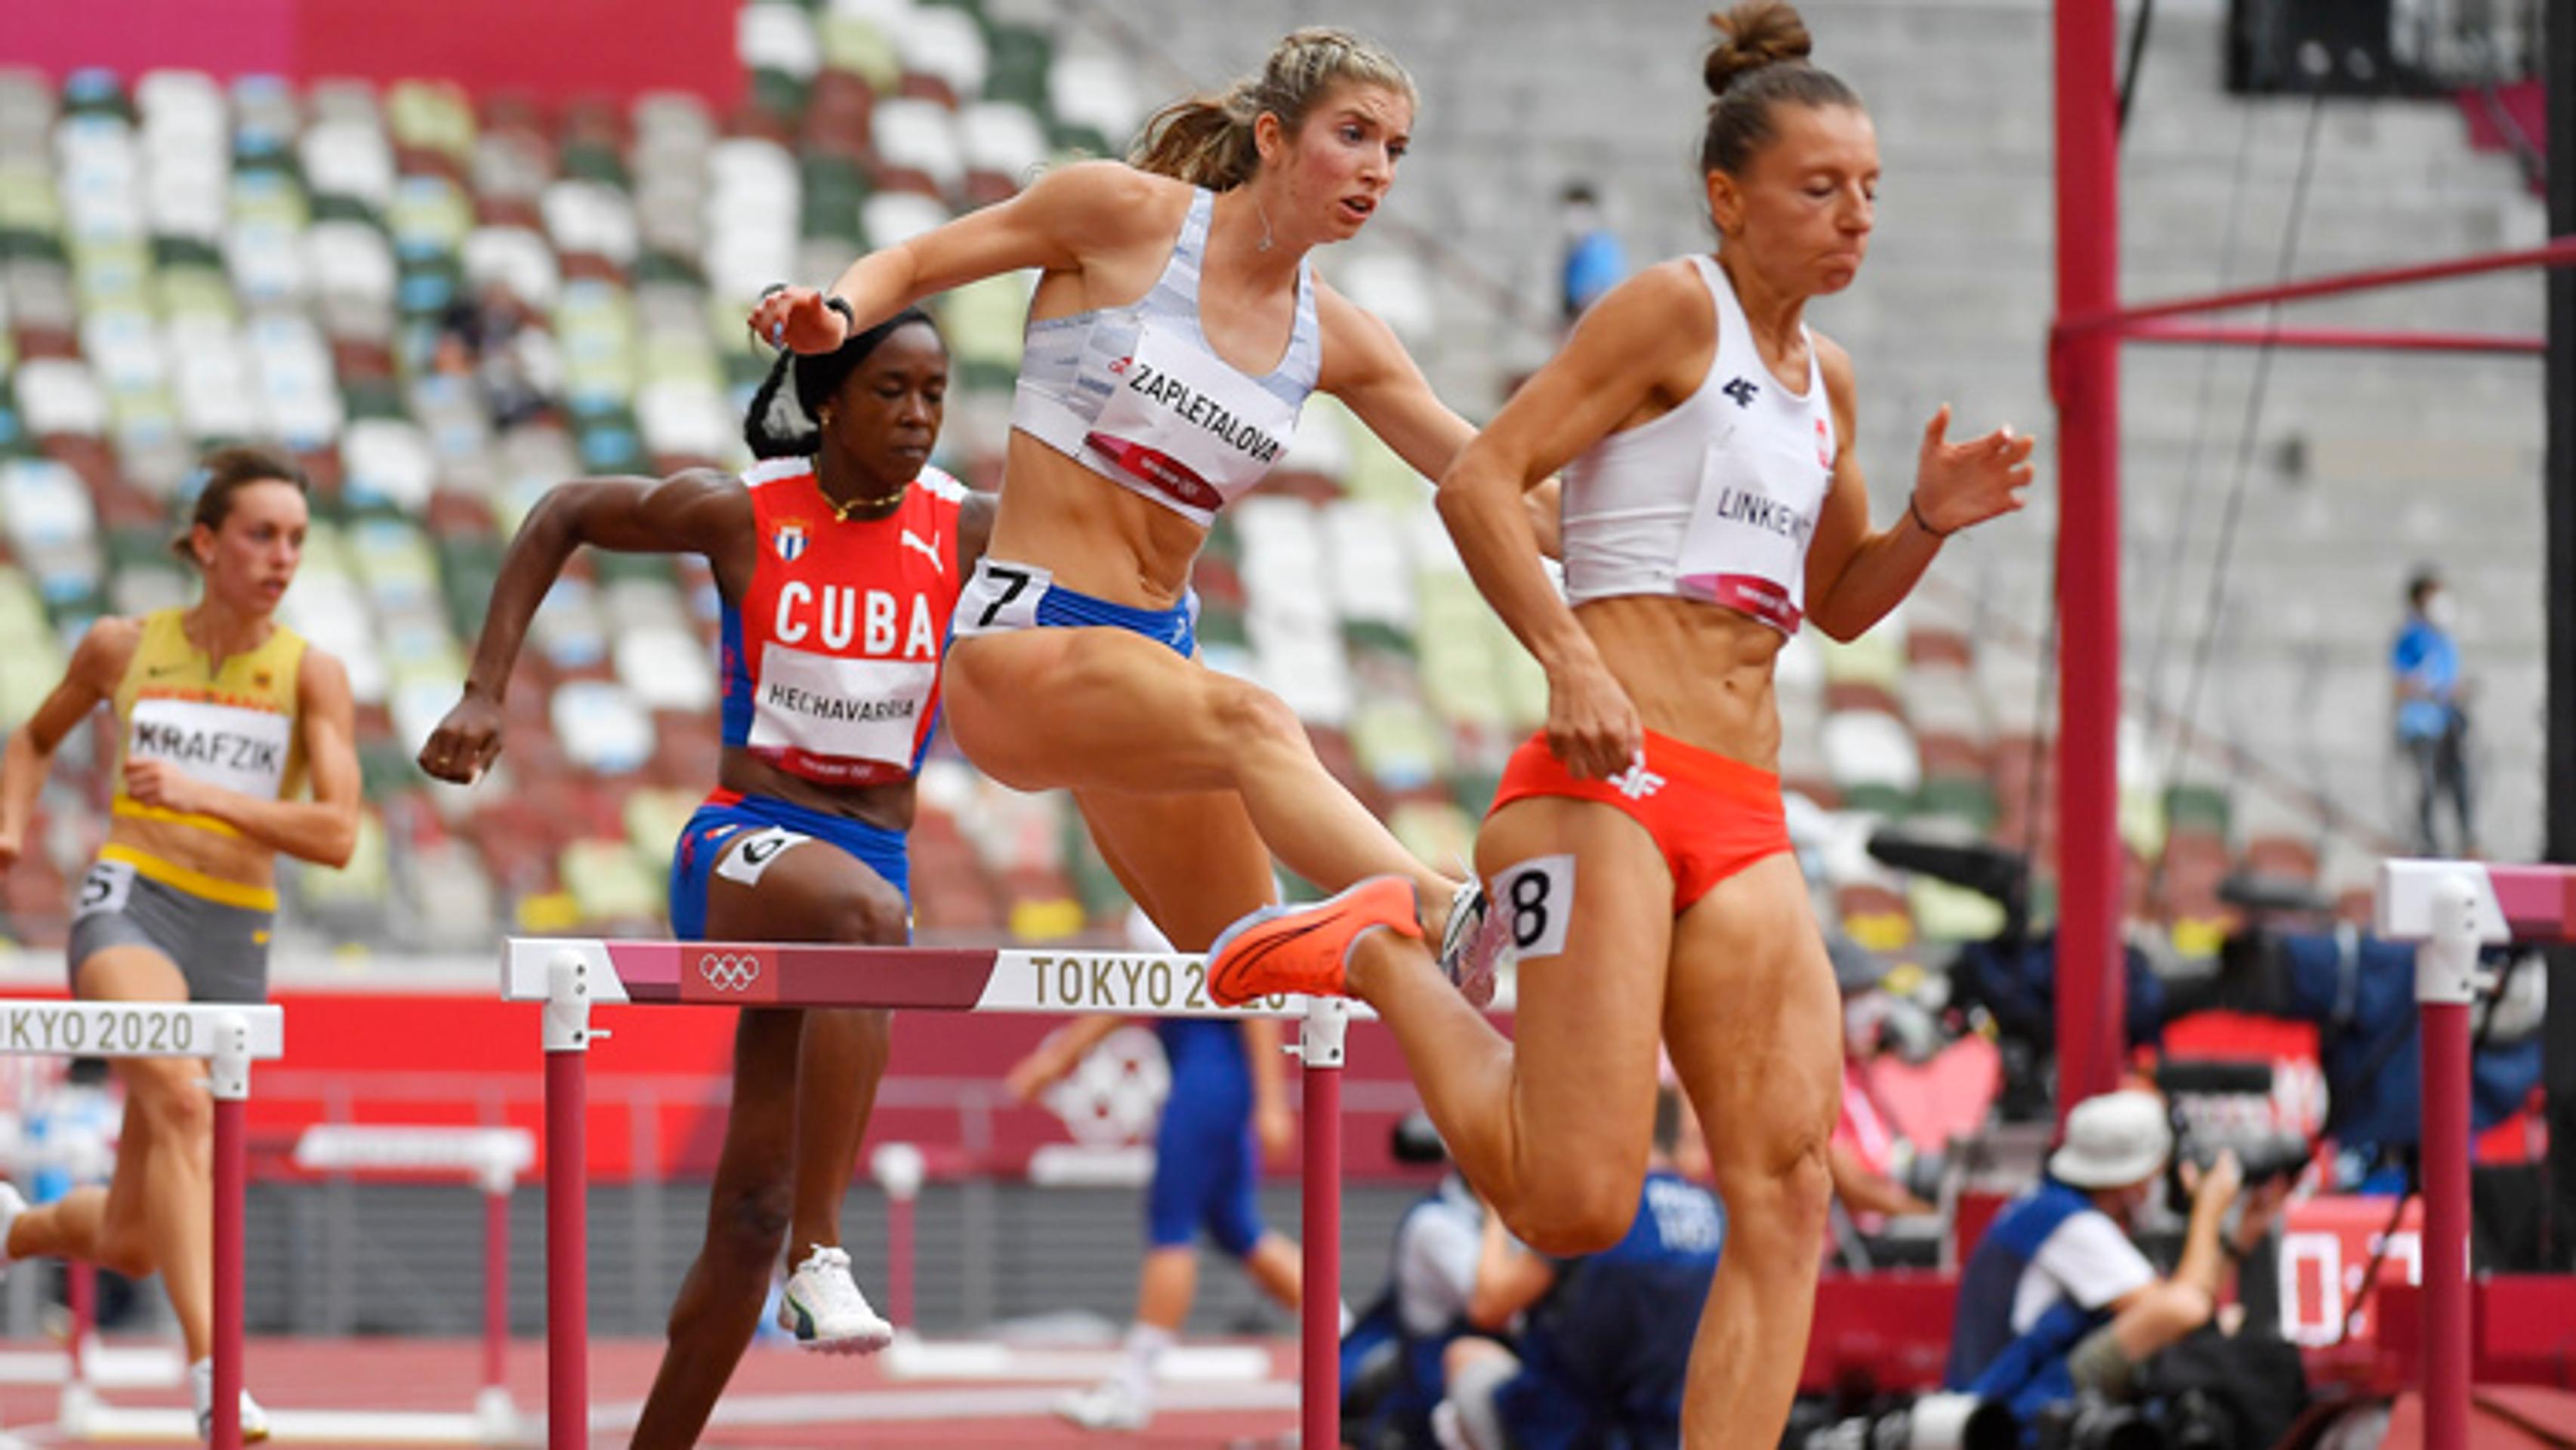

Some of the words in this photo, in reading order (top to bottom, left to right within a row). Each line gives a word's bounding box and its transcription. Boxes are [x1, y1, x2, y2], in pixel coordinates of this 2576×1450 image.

[1129, 364, 1280, 463] ZAPLETALOVA
[775, 580, 936, 659] CUBA
[978, 568, 1031, 627] 7
[136, 720, 279, 775] KRAFZIK
[742, 838, 786, 865] 6
[82, 863, 116, 907] 5
[1510, 868, 1551, 948] 8
[1029, 957, 1172, 1007] TOKYO
[0, 1009, 86, 1050] KYO
[98, 1010, 193, 1050] 2020
